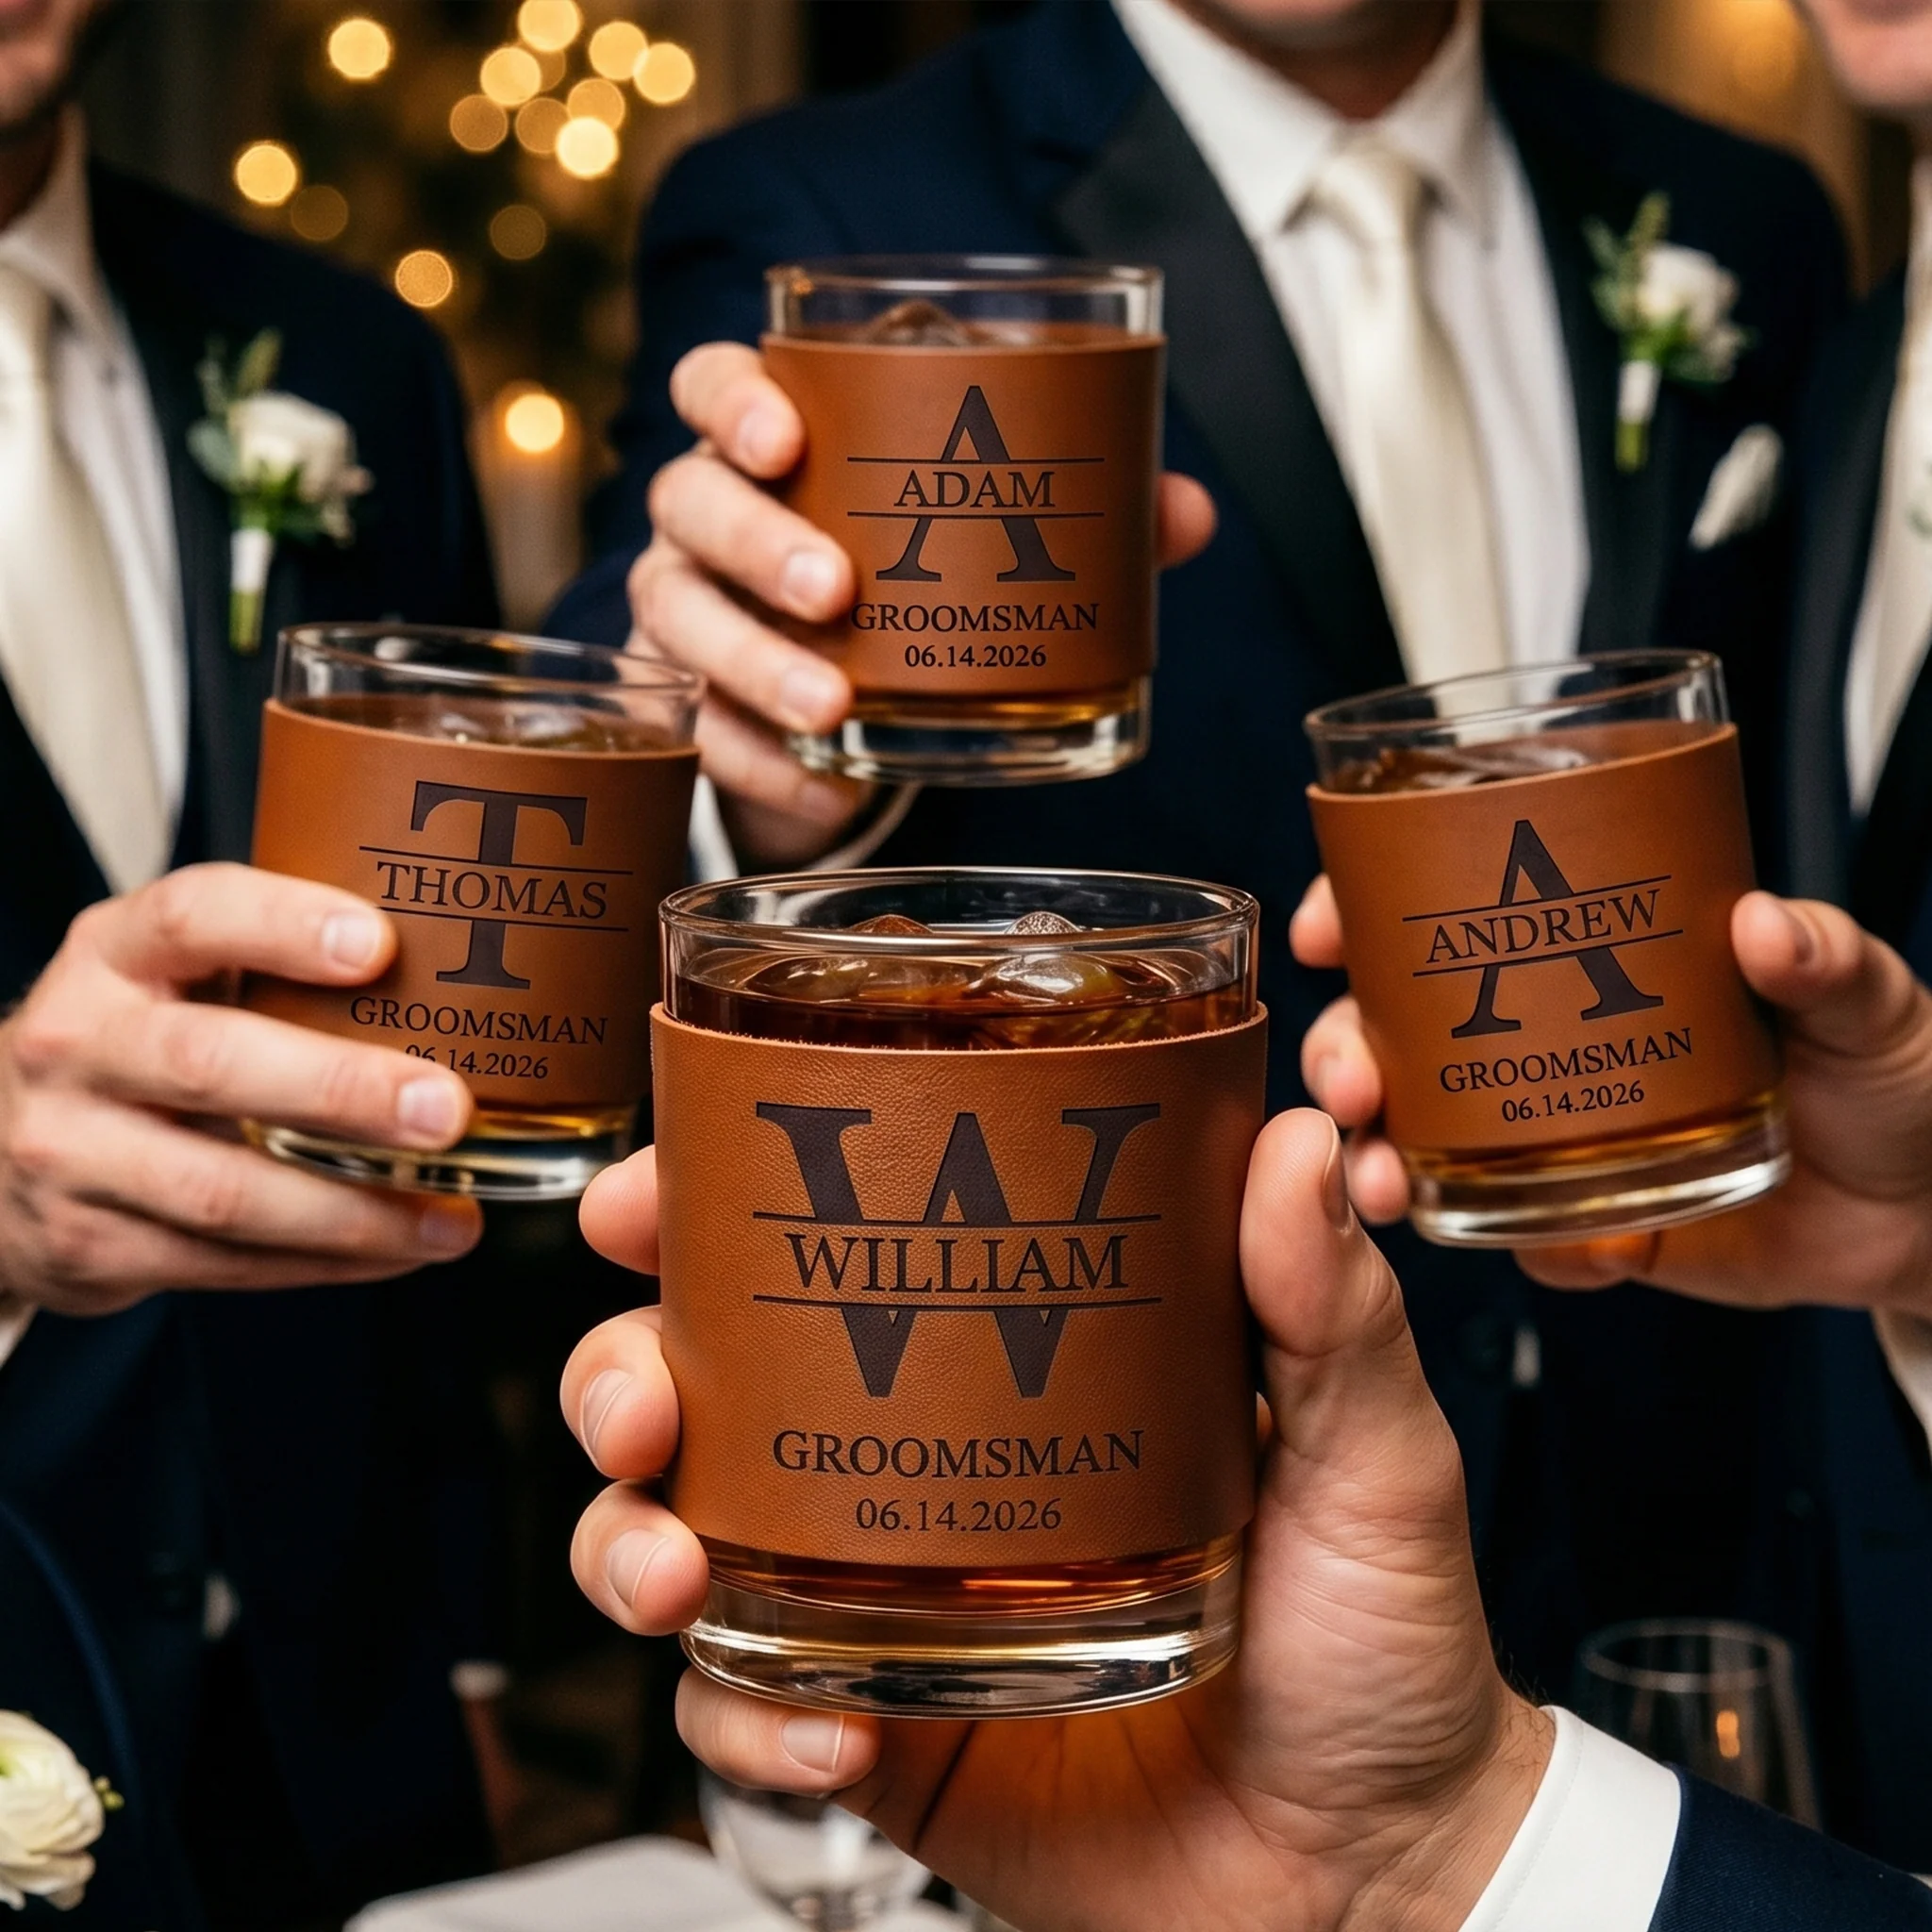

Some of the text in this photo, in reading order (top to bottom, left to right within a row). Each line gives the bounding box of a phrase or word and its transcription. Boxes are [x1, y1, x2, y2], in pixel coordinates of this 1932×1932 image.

[875, 385, 1075, 582] A
[894, 470, 1056, 508] ADAM
[851, 603, 1099, 631] GROOMSMAN
[905, 644, 1046, 667] 06.14.2026
[377, 860, 608, 919] THOMAS
[410, 780, 588, 990] T
[1426, 889, 1660, 963] ANDREW
[1451, 819, 1664, 1039] A
[351, 996, 608, 1044] GROOMSMAN
[406, 1043, 548, 1079] 614.2026
[1440, 1027, 1692, 1092] GROOMSMAN
[1502, 1080, 1645, 1122] 06.14.2026
[757, 1101, 1160, 1398] W
[784, 1233, 1128, 1293] WILLIAM
[773, 1430, 1144, 1478] GROOMSMAN
[856, 1497, 1061, 1532] 06.14.2026
